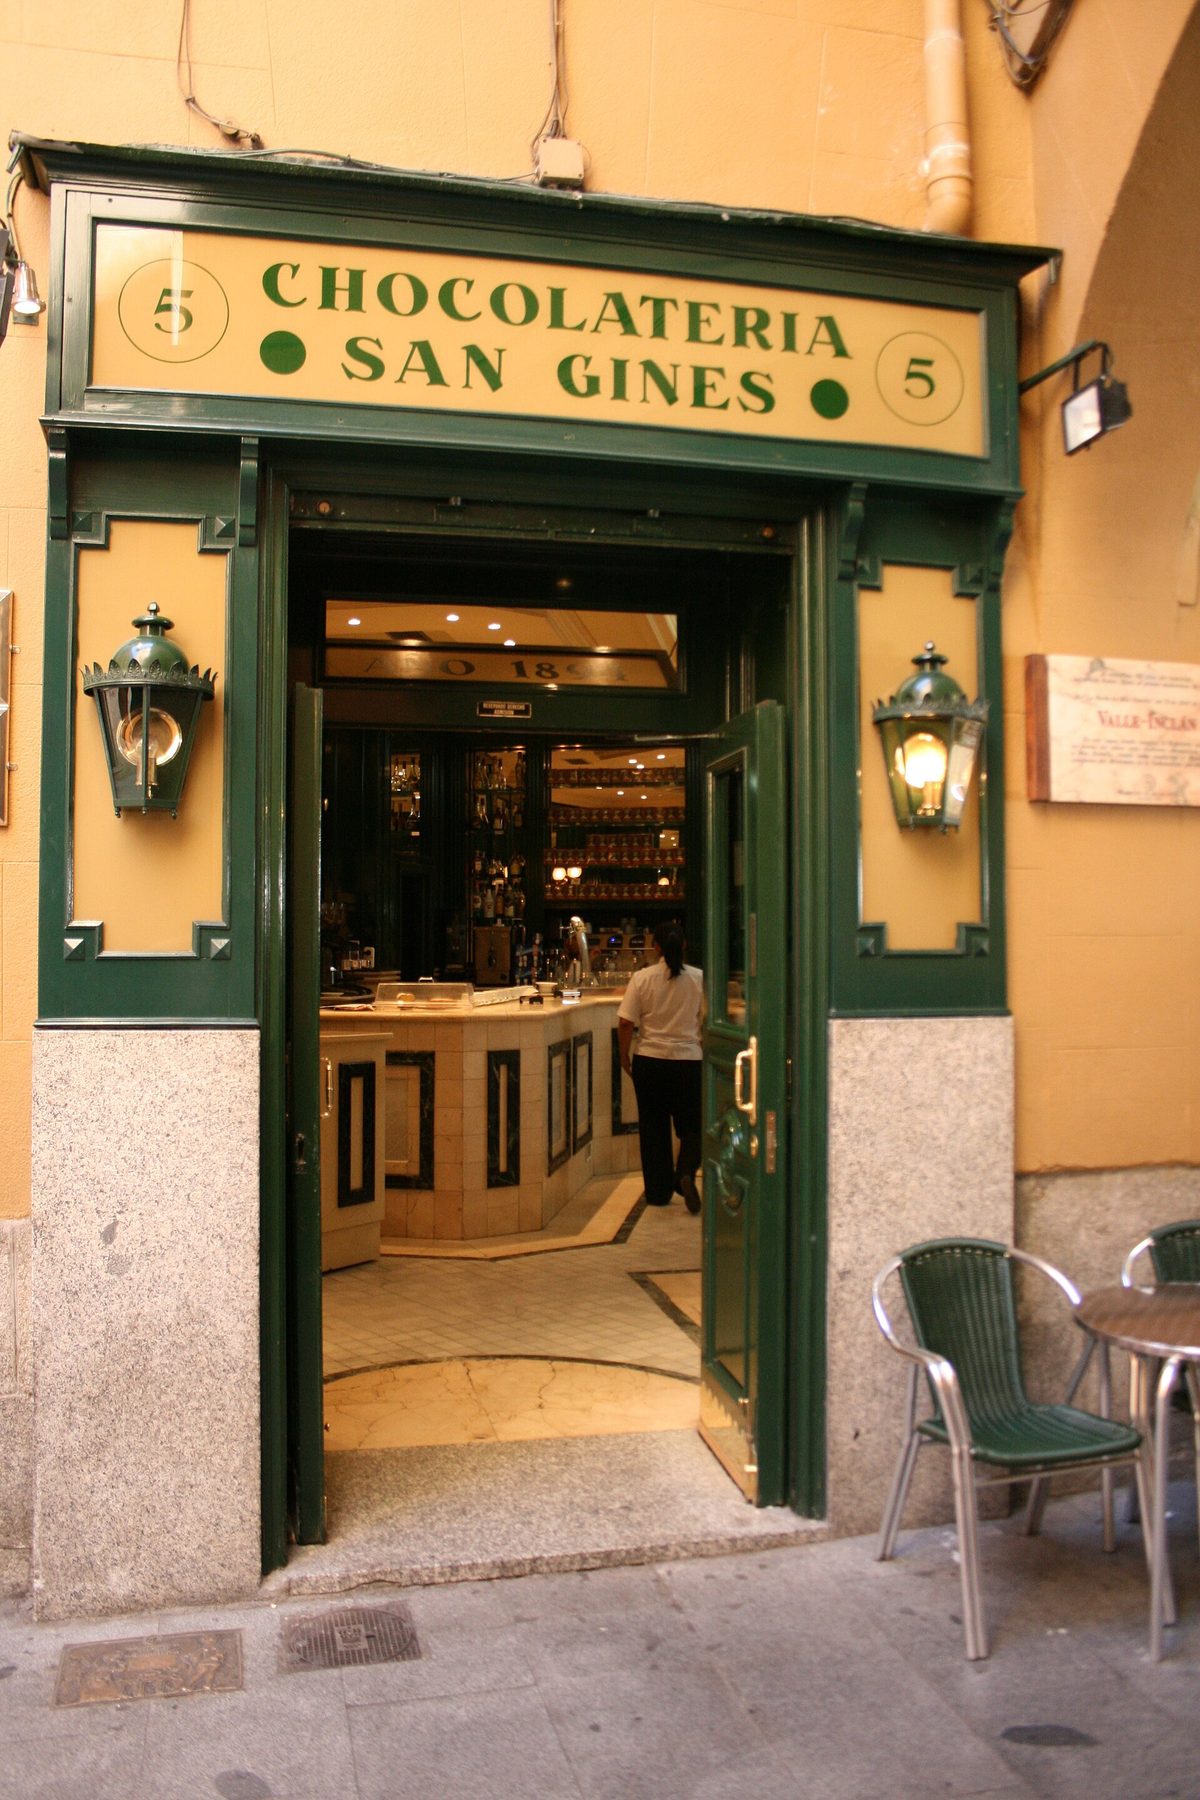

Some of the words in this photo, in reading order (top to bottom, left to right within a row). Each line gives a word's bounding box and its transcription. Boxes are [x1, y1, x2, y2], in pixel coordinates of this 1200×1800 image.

[154, 288, 193, 334] 5
[262, 263, 849, 358] CHOCOLATERIA
[341, 336, 505, 392] SAN
[557, 354, 776, 414] GINES
[905, 357, 936, 399] 5
